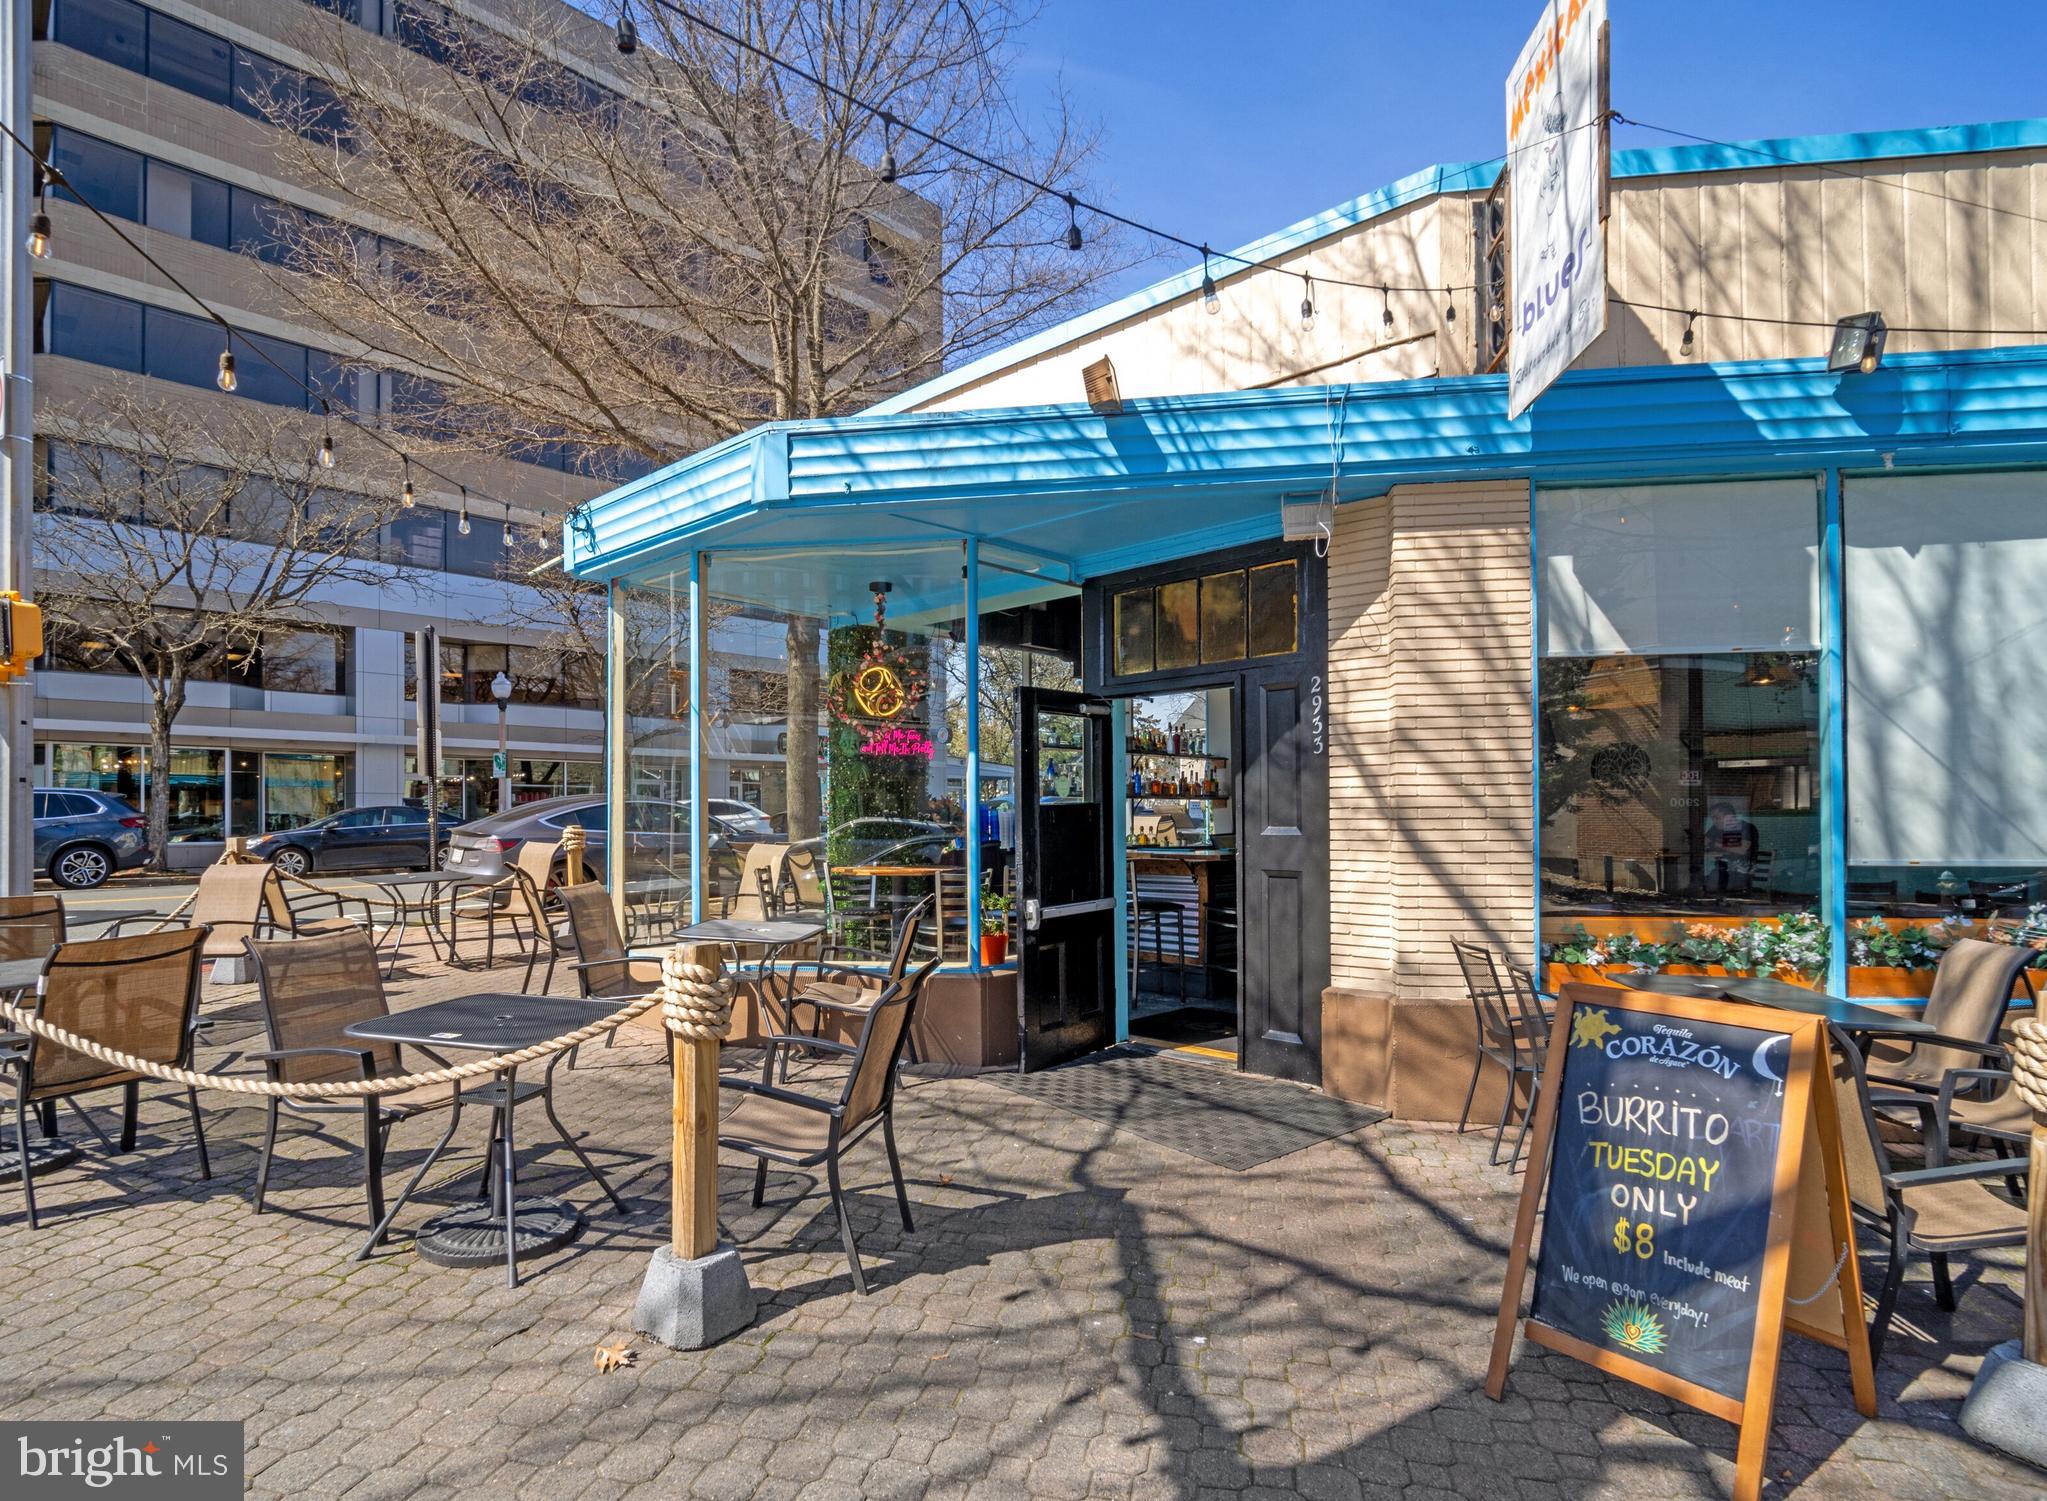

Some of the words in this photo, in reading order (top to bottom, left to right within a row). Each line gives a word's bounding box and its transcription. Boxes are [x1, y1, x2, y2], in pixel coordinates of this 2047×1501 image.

[1310, 675, 1324, 754] 2933
[1653, 1024, 1693, 1039] Tequila
[1606, 1036, 1741, 1079] CORAZÓN
[1588, 1141, 1720, 1192] TUESDAY
[1611, 1183, 1697, 1225] ONLY
[1613, 1216, 1654, 1259] $8
[1562, 1265, 1580, 1283] We
[1582, 1275, 1608, 1291] open
[1663, 1250, 1711, 1279] Include
[1715, 1269, 1750, 1292] meat
